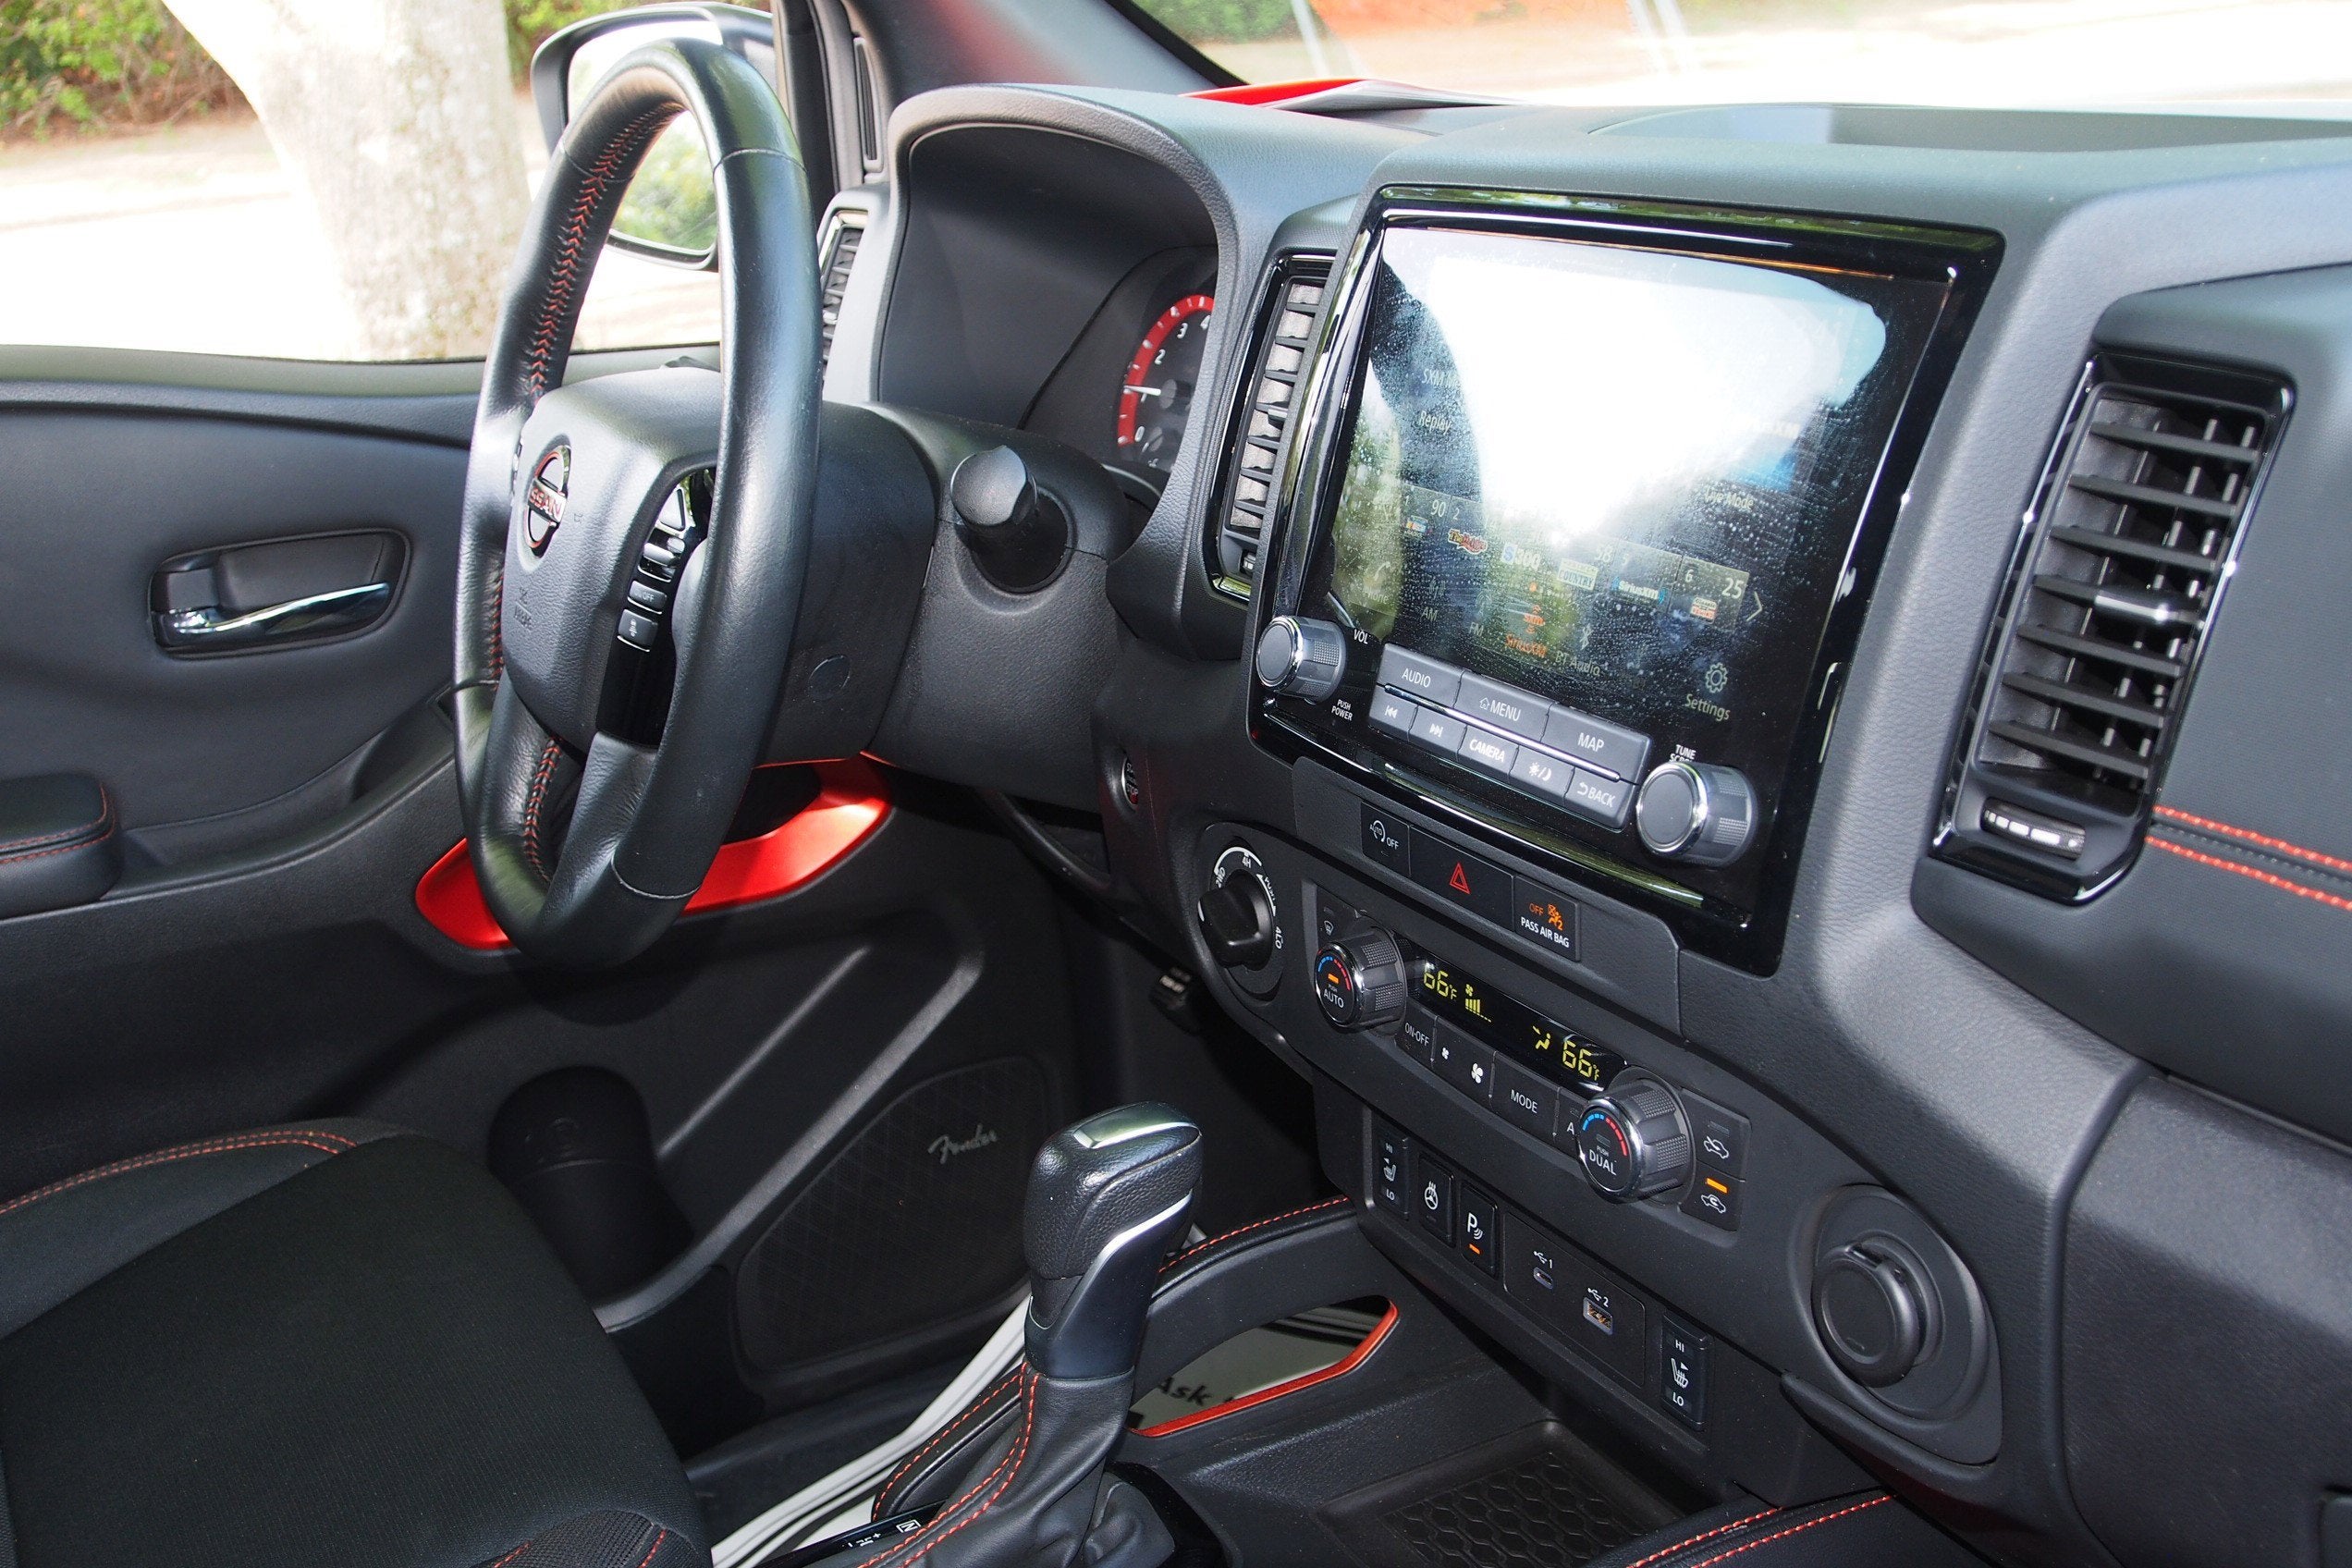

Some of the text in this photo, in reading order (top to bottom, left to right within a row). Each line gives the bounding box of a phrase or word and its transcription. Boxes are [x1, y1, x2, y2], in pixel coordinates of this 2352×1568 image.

[1176, 322, 1188, 339] 3
[1154, 349, 1166, 365] 2
[1134, 425, 1145, 442] 0
[1721, 577, 1745, 599] 25
[1354, 628, 1369, 645] VOL
[1401, 668, 1431, 688] AUDIO
[1331, 705, 1354, 722] POWER
[1337, 699, 1352, 711] PUSH
[1489, 699, 1522, 722] MENU
[1684, 692, 1732, 723] Settings
[1469, 739, 1506, 763] CAMERA
[1577, 731, 1605, 753] MAP
[1675, 743, 1697, 760] TUNE
[1587, 786, 1616, 809] BACK
[1386, 837, 1400, 850] OFF
[1528, 902, 1544, 916] OFF
[1520, 916, 1570, 949] PASS AIR BAG
[1323, 988, 1344, 1009] AUTO
[1511, 1089, 1538, 1114] MODE
[1589, 1148, 1617, 1176] DUAL
[1675, 1339, 1685, 1353] HI
[1672, 1391, 1684, 1407] LO
